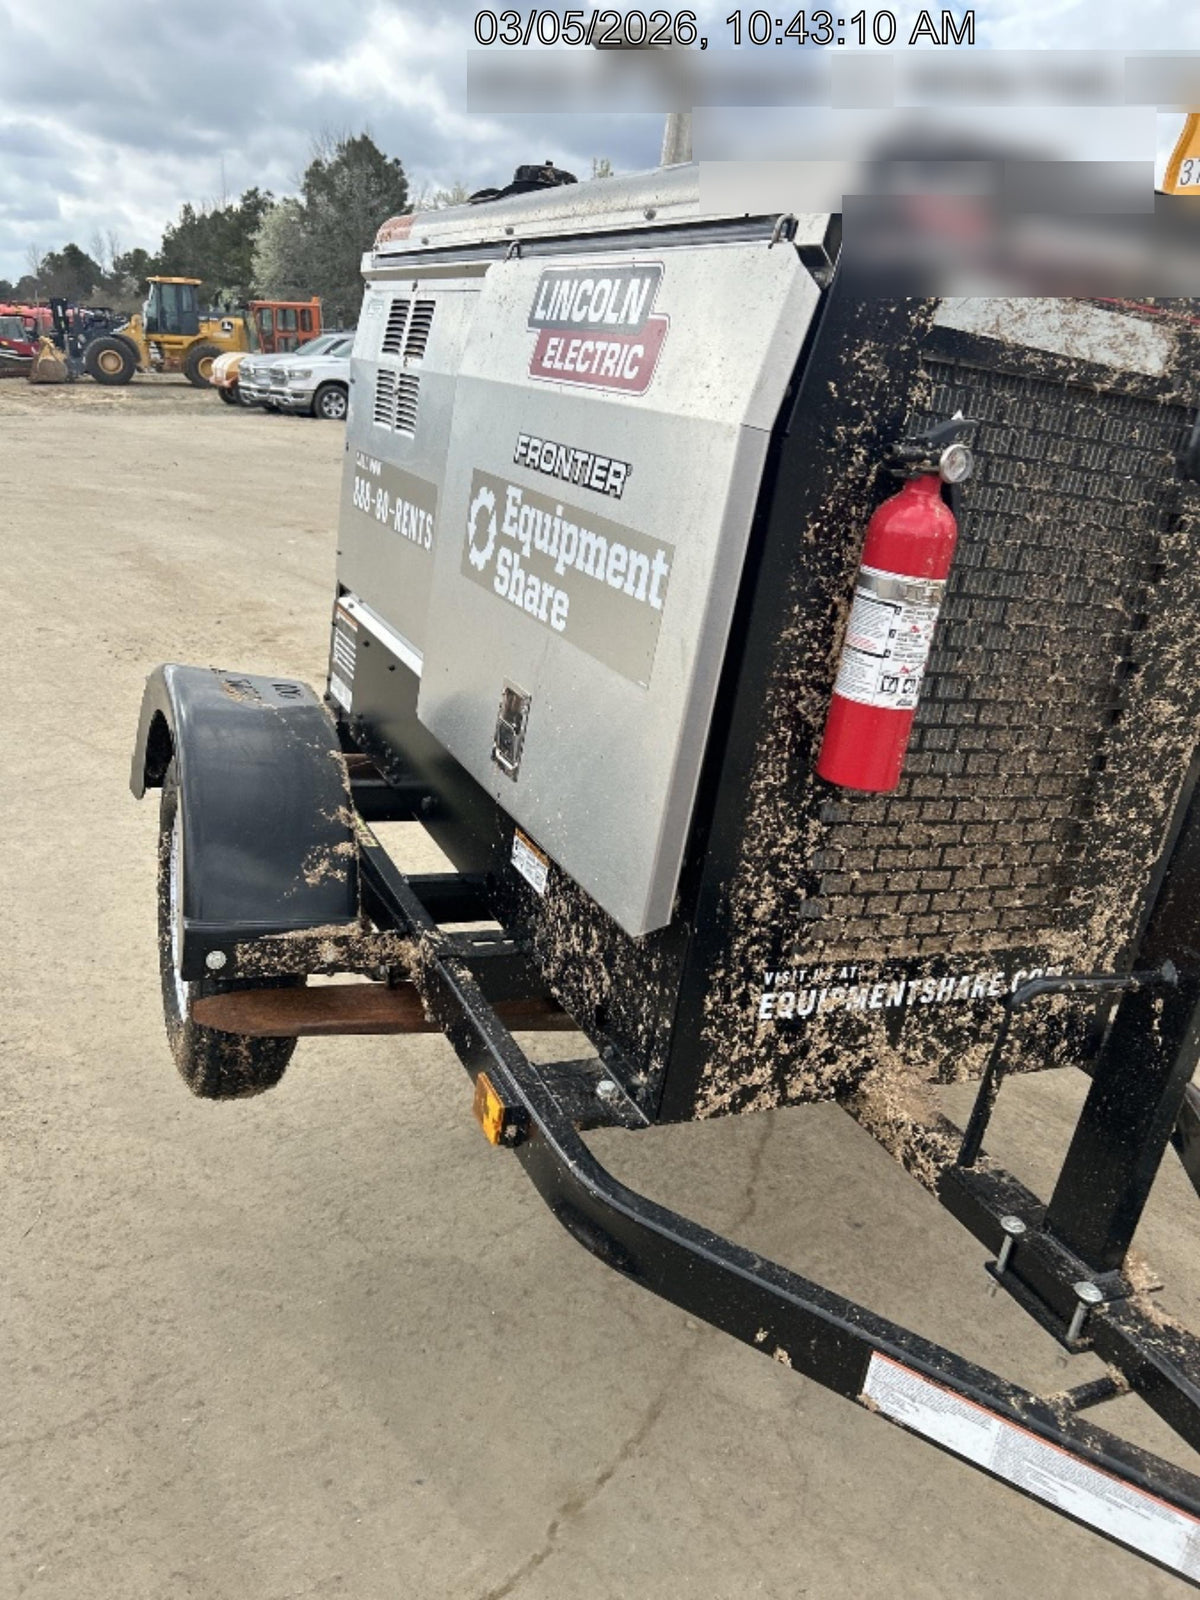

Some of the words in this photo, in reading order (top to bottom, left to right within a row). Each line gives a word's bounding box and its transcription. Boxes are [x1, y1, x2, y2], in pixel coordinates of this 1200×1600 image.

[534, 277, 652, 326] LINCOLN
[541, 337, 645, 381] ELECTRIC
[501, 485, 670, 610] Equipment
[494, 548, 570, 632] Share
[764, 970, 807, 985] VISIT
